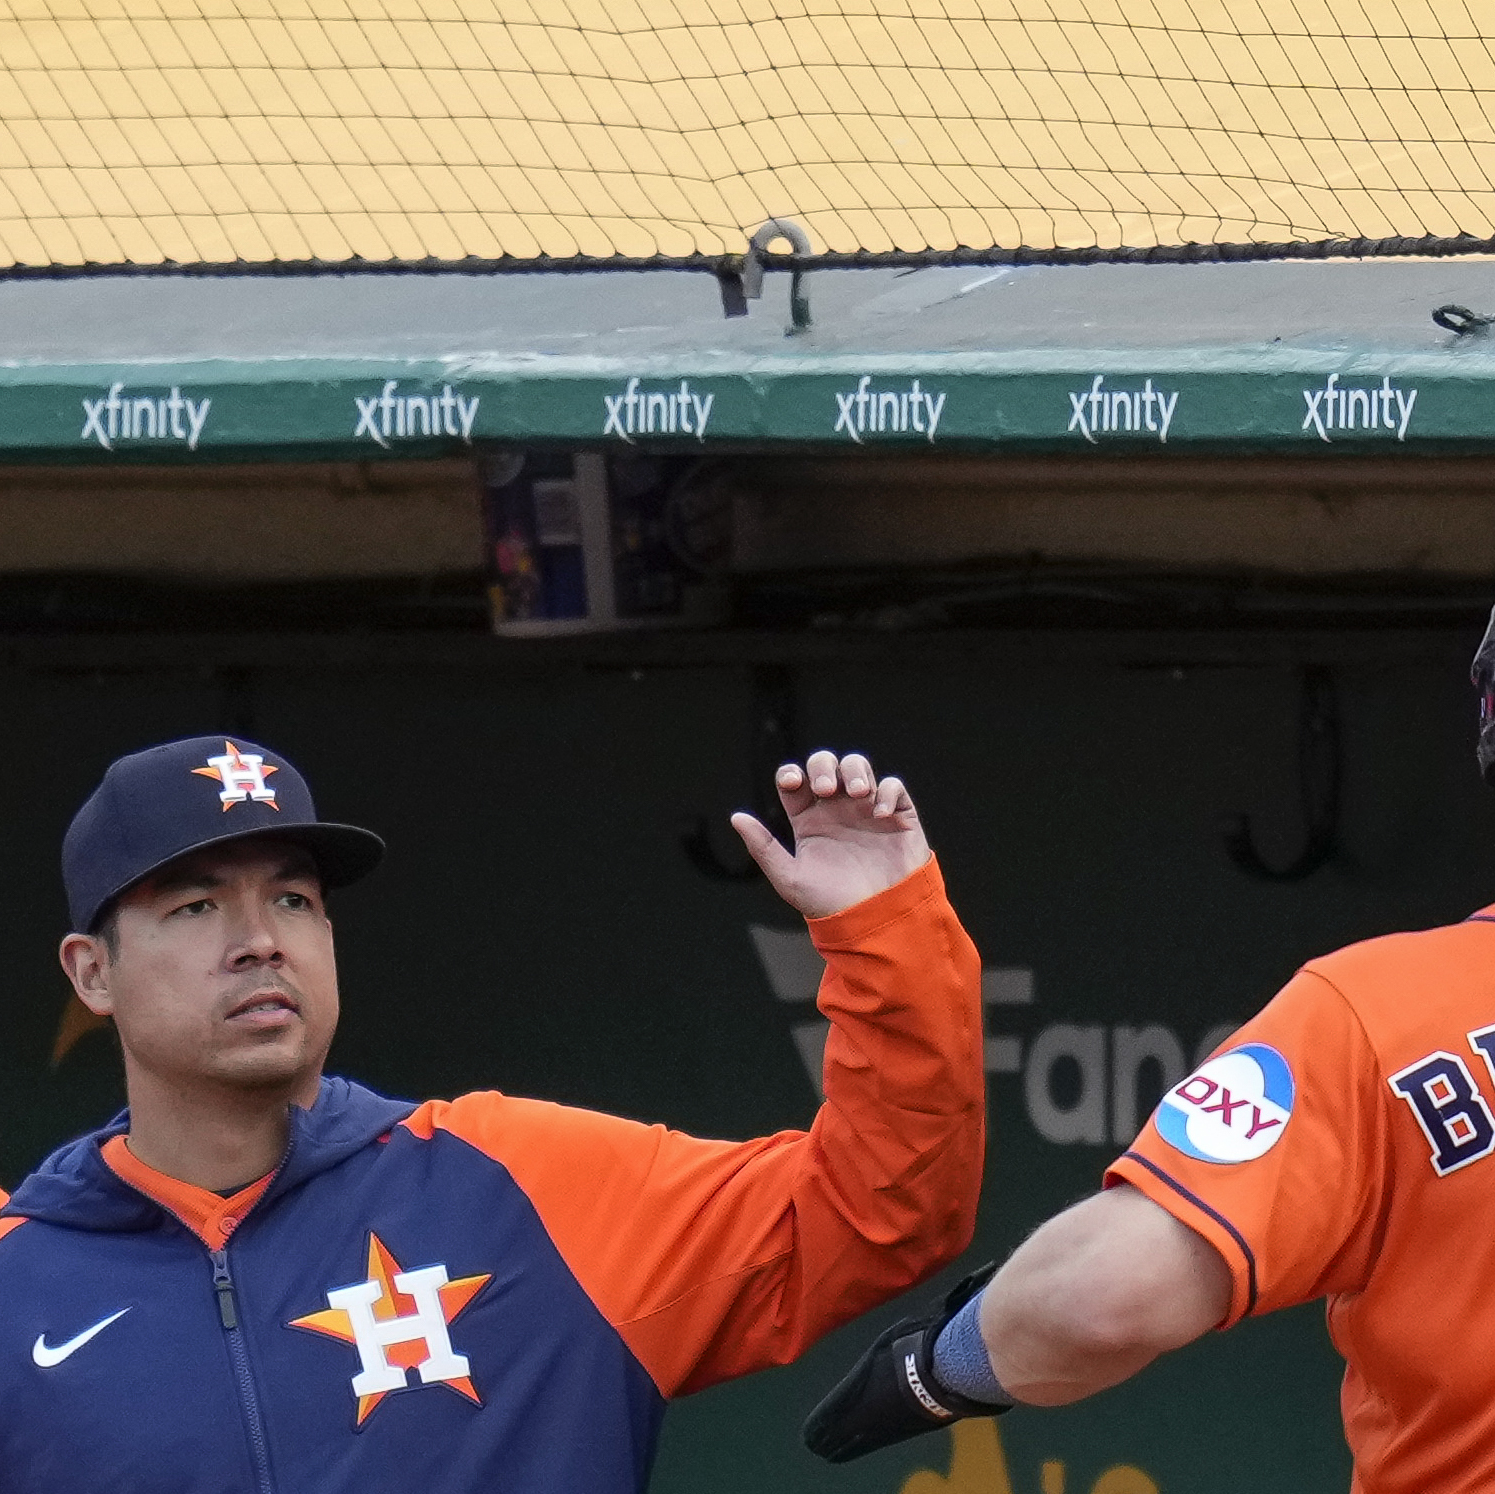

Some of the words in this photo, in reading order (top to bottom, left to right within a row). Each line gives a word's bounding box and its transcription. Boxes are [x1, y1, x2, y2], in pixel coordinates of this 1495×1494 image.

[81, 381, 211, 451] xfinity
[355, 381, 479, 448] xfinity
[604, 377, 714, 445] xfinity
[834, 376, 946, 445] xfinity
[1068, 375, 1179, 443] xfinity
[1303, 373, 1418, 443] xfinity
[218, 753, 276, 802] H
[1175, 1075, 1283, 1141] OXY
